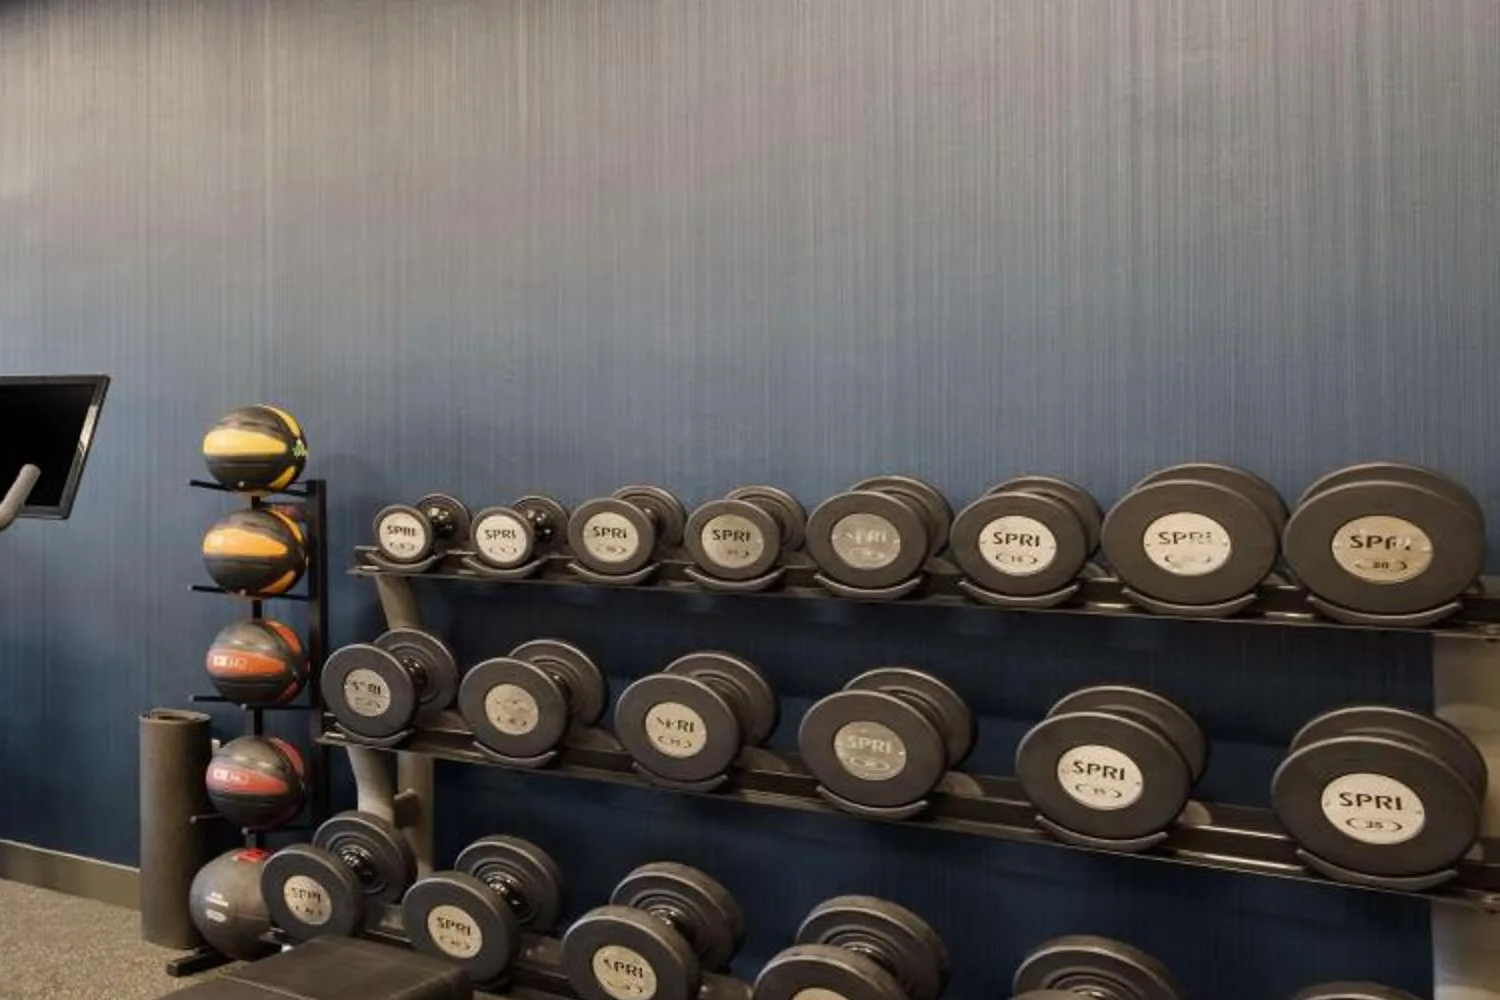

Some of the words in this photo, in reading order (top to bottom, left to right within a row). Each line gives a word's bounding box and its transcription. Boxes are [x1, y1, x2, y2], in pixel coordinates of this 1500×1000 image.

[592, 525, 628, 539] SPRI
[712, 529, 752, 542] SPRI
[992, 531, 1041, 547] SPRI
[1349, 534, 1411, 551] SPR
[1072, 760, 1125, 781] SPRI
[1339, 791, 1403, 811] SPRI
